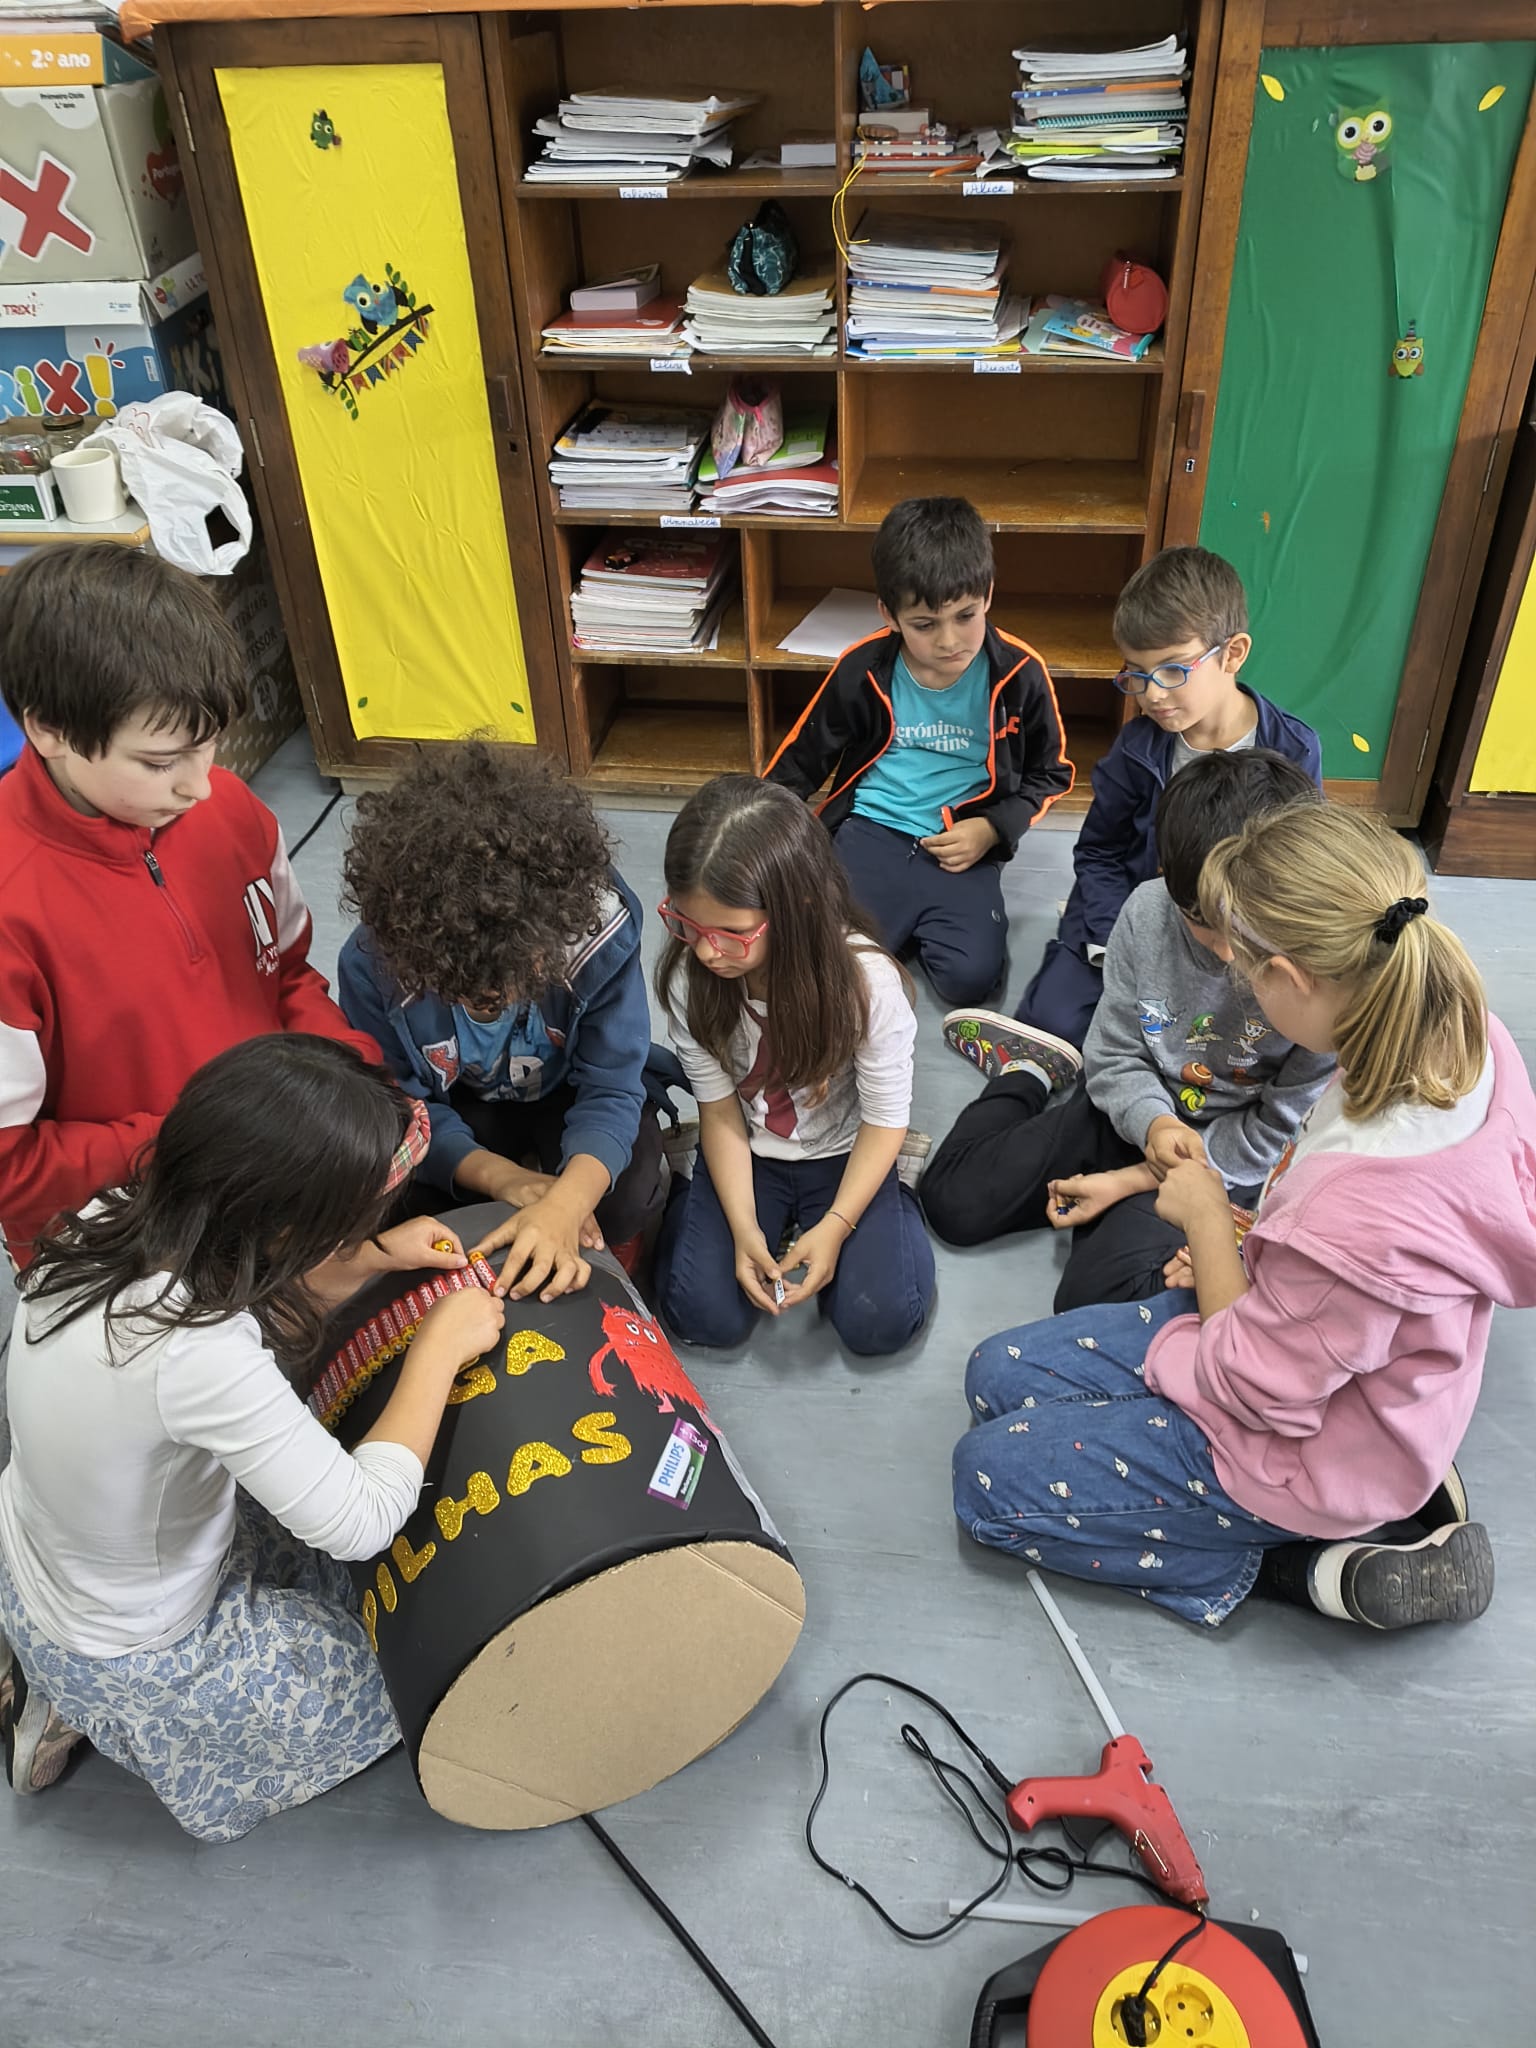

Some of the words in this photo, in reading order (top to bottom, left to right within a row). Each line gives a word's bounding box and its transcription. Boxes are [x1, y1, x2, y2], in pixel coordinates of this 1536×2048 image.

[57, 52, 91, 68] ano
[895, 719, 975, 739] erónimo
[658, 1442, 685, 1487] PHILIPS
